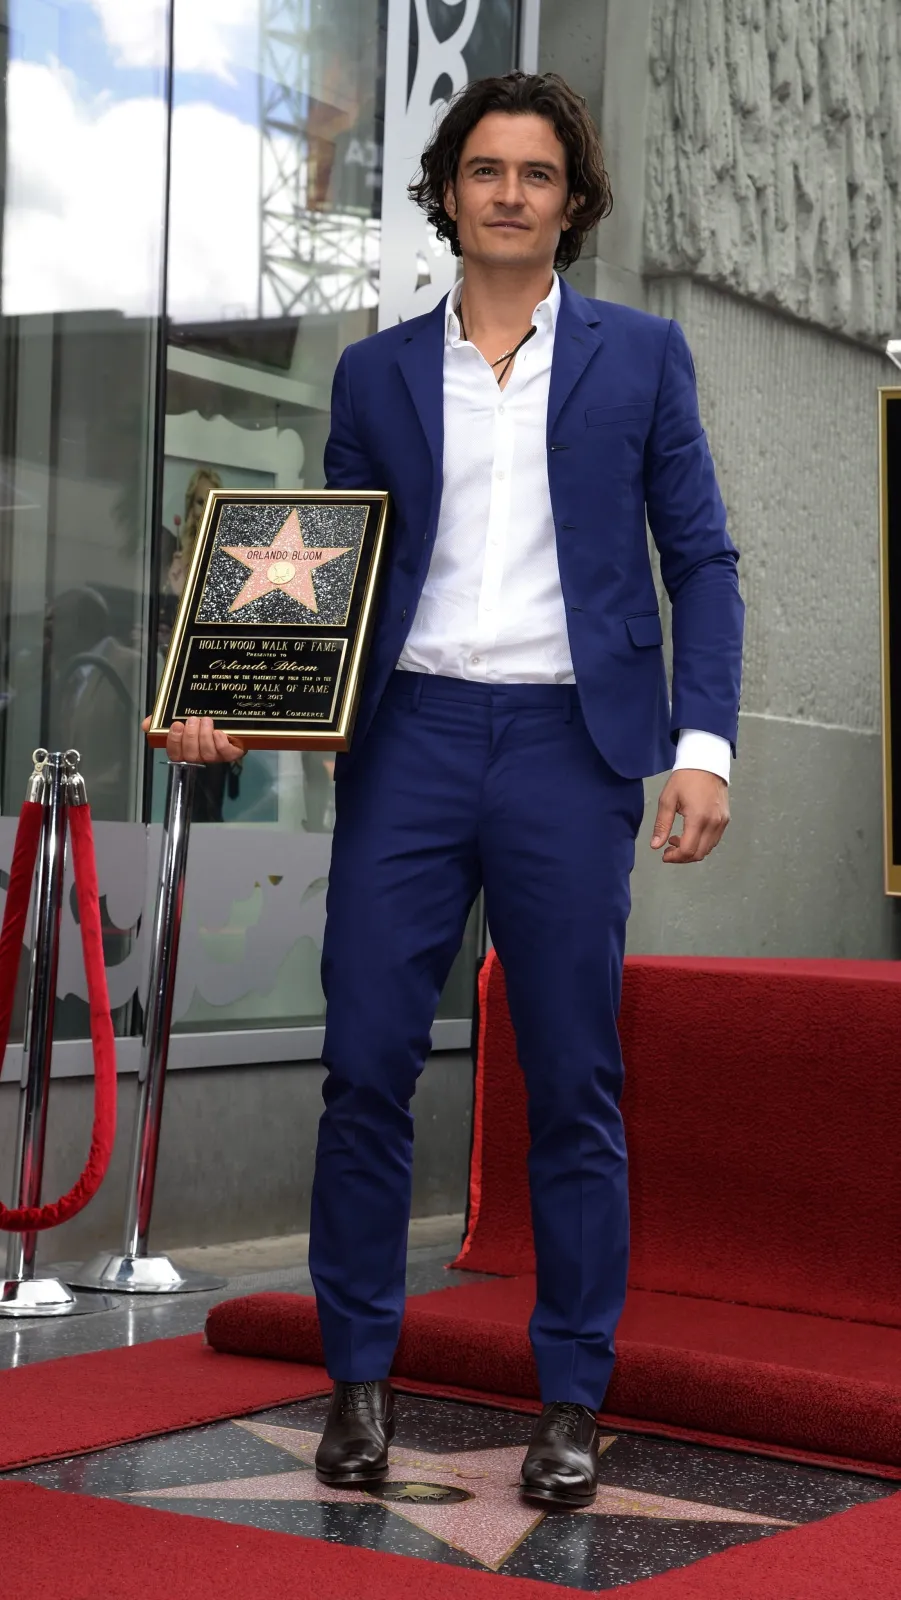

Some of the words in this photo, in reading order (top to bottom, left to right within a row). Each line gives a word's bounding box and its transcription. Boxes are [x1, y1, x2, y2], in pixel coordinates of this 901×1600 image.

[247, 550, 288, 560] ORLANDO
[292, 551, 322, 560] BLOOM
[199, 640, 255, 650] HOLLYWOOD
[262, 640, 288, 651] WALK
[294, 642, 306, 651] OF
[310, 642, 336, 652] FAME
[209, 660, 268, 670] Orlando
[270, 660, 319, 672] Bloom
[190, 682, 247, 692] HOLLYWOOD
[254, 684, 280, 693] WALK
[286, 684, 298, 693] OF
[303, 684, 330, 694] FAME
